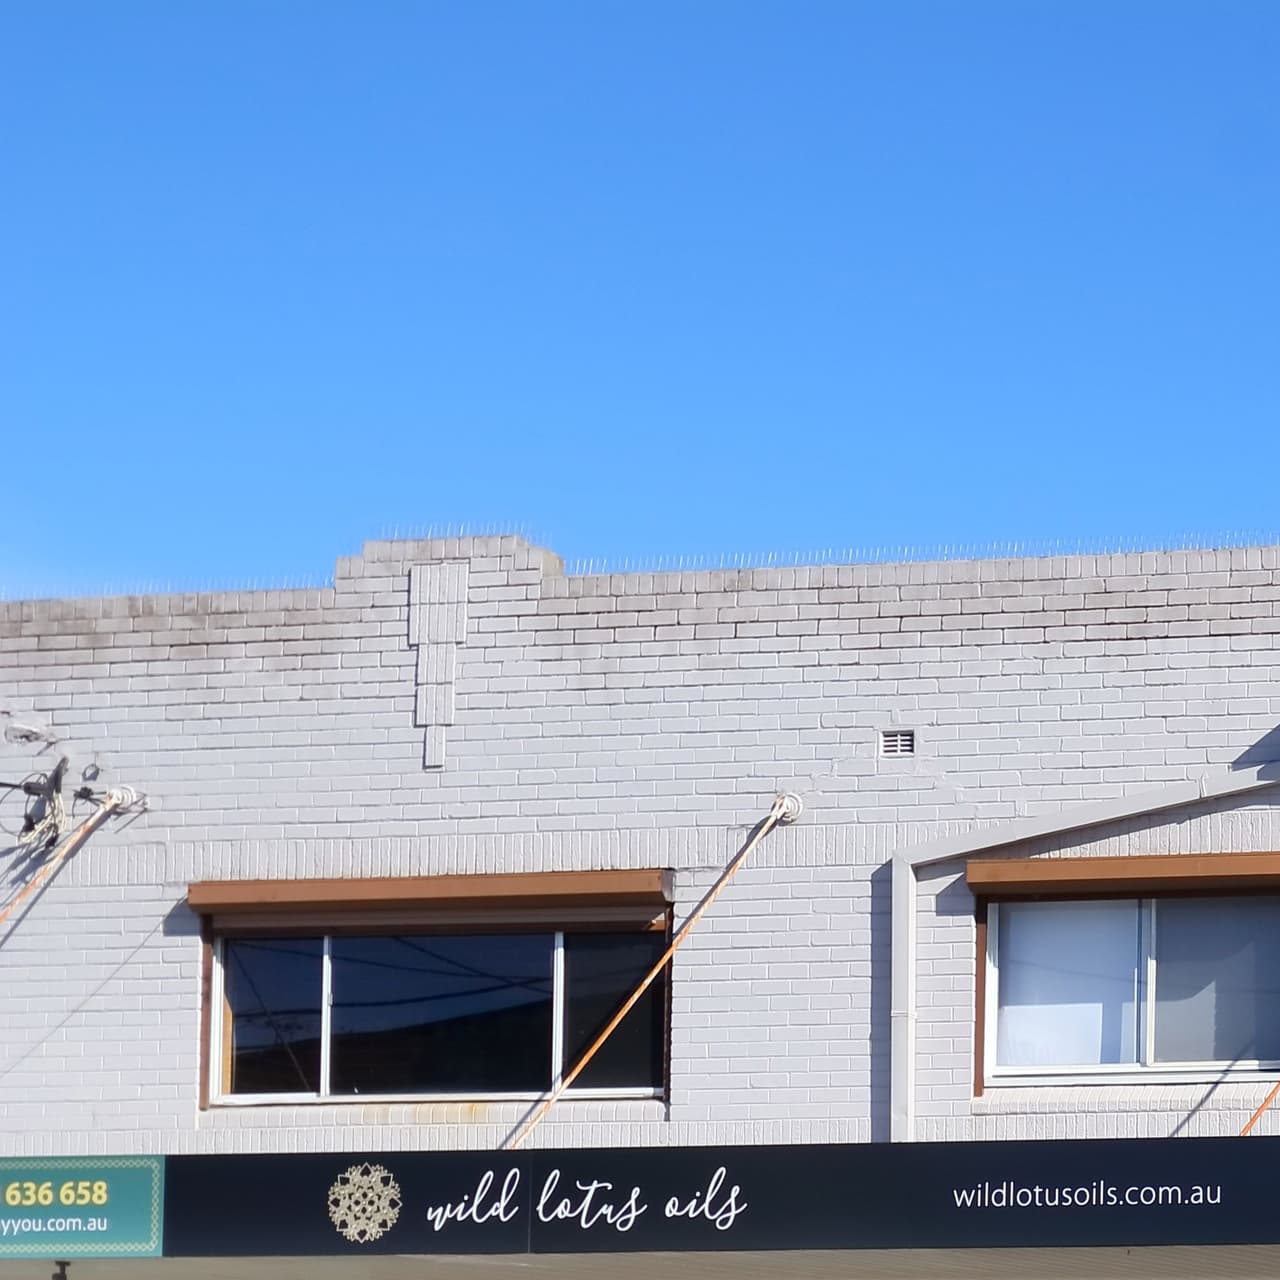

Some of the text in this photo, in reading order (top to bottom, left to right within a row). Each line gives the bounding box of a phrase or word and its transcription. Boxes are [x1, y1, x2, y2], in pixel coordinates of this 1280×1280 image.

[5, 1181, 109, 1206] 636 658
[426, 1166, 748, 1232] wild lotus oils
[953, 1179, 1222, 1208] wildlotusoils.com.au
